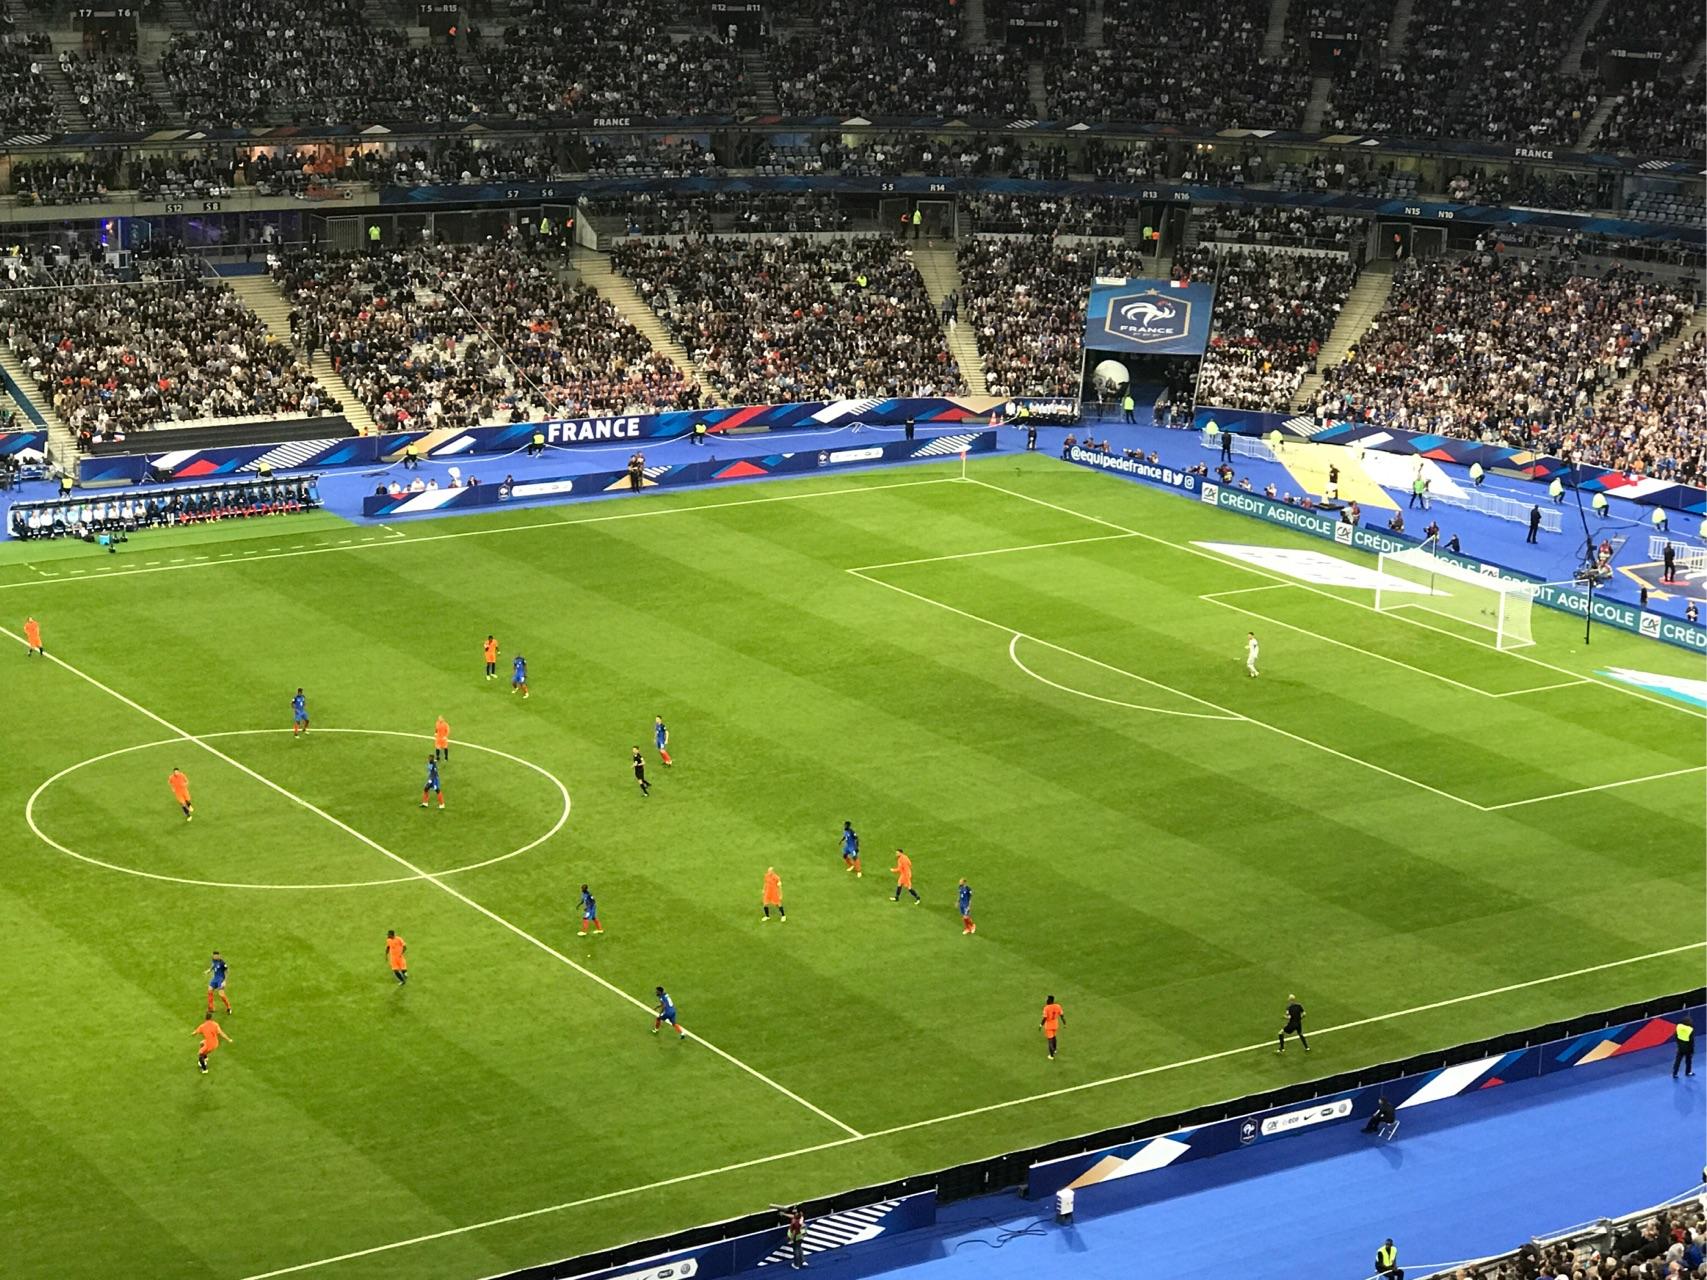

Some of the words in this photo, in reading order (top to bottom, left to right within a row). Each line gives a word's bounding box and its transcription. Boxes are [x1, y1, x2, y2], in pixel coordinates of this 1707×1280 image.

[593, 117, 630, 127] FRANCE
[1515, 148, 1553, 159] FRANCE
[930, 184, 945, 192] R14
[1142, 191, 1158, 199] R13
[1404, 207, 1421, 216] N15
[1120, 325, 1174, 334] FRANCE
[548, 417, 640, 443] FRANCE
[1070, 446, 1162, 479] @equipedefrance
[1220, 492, 1265, 514] CRÉDIT
[1267, 506, 1331, 534] AGRICOLE
[1355, 531, 1403, 553] CRÉDIT
[1557, 592, 1635, 627] AGRICOLE
[1663, 624, 1707, 647] CRÉD
